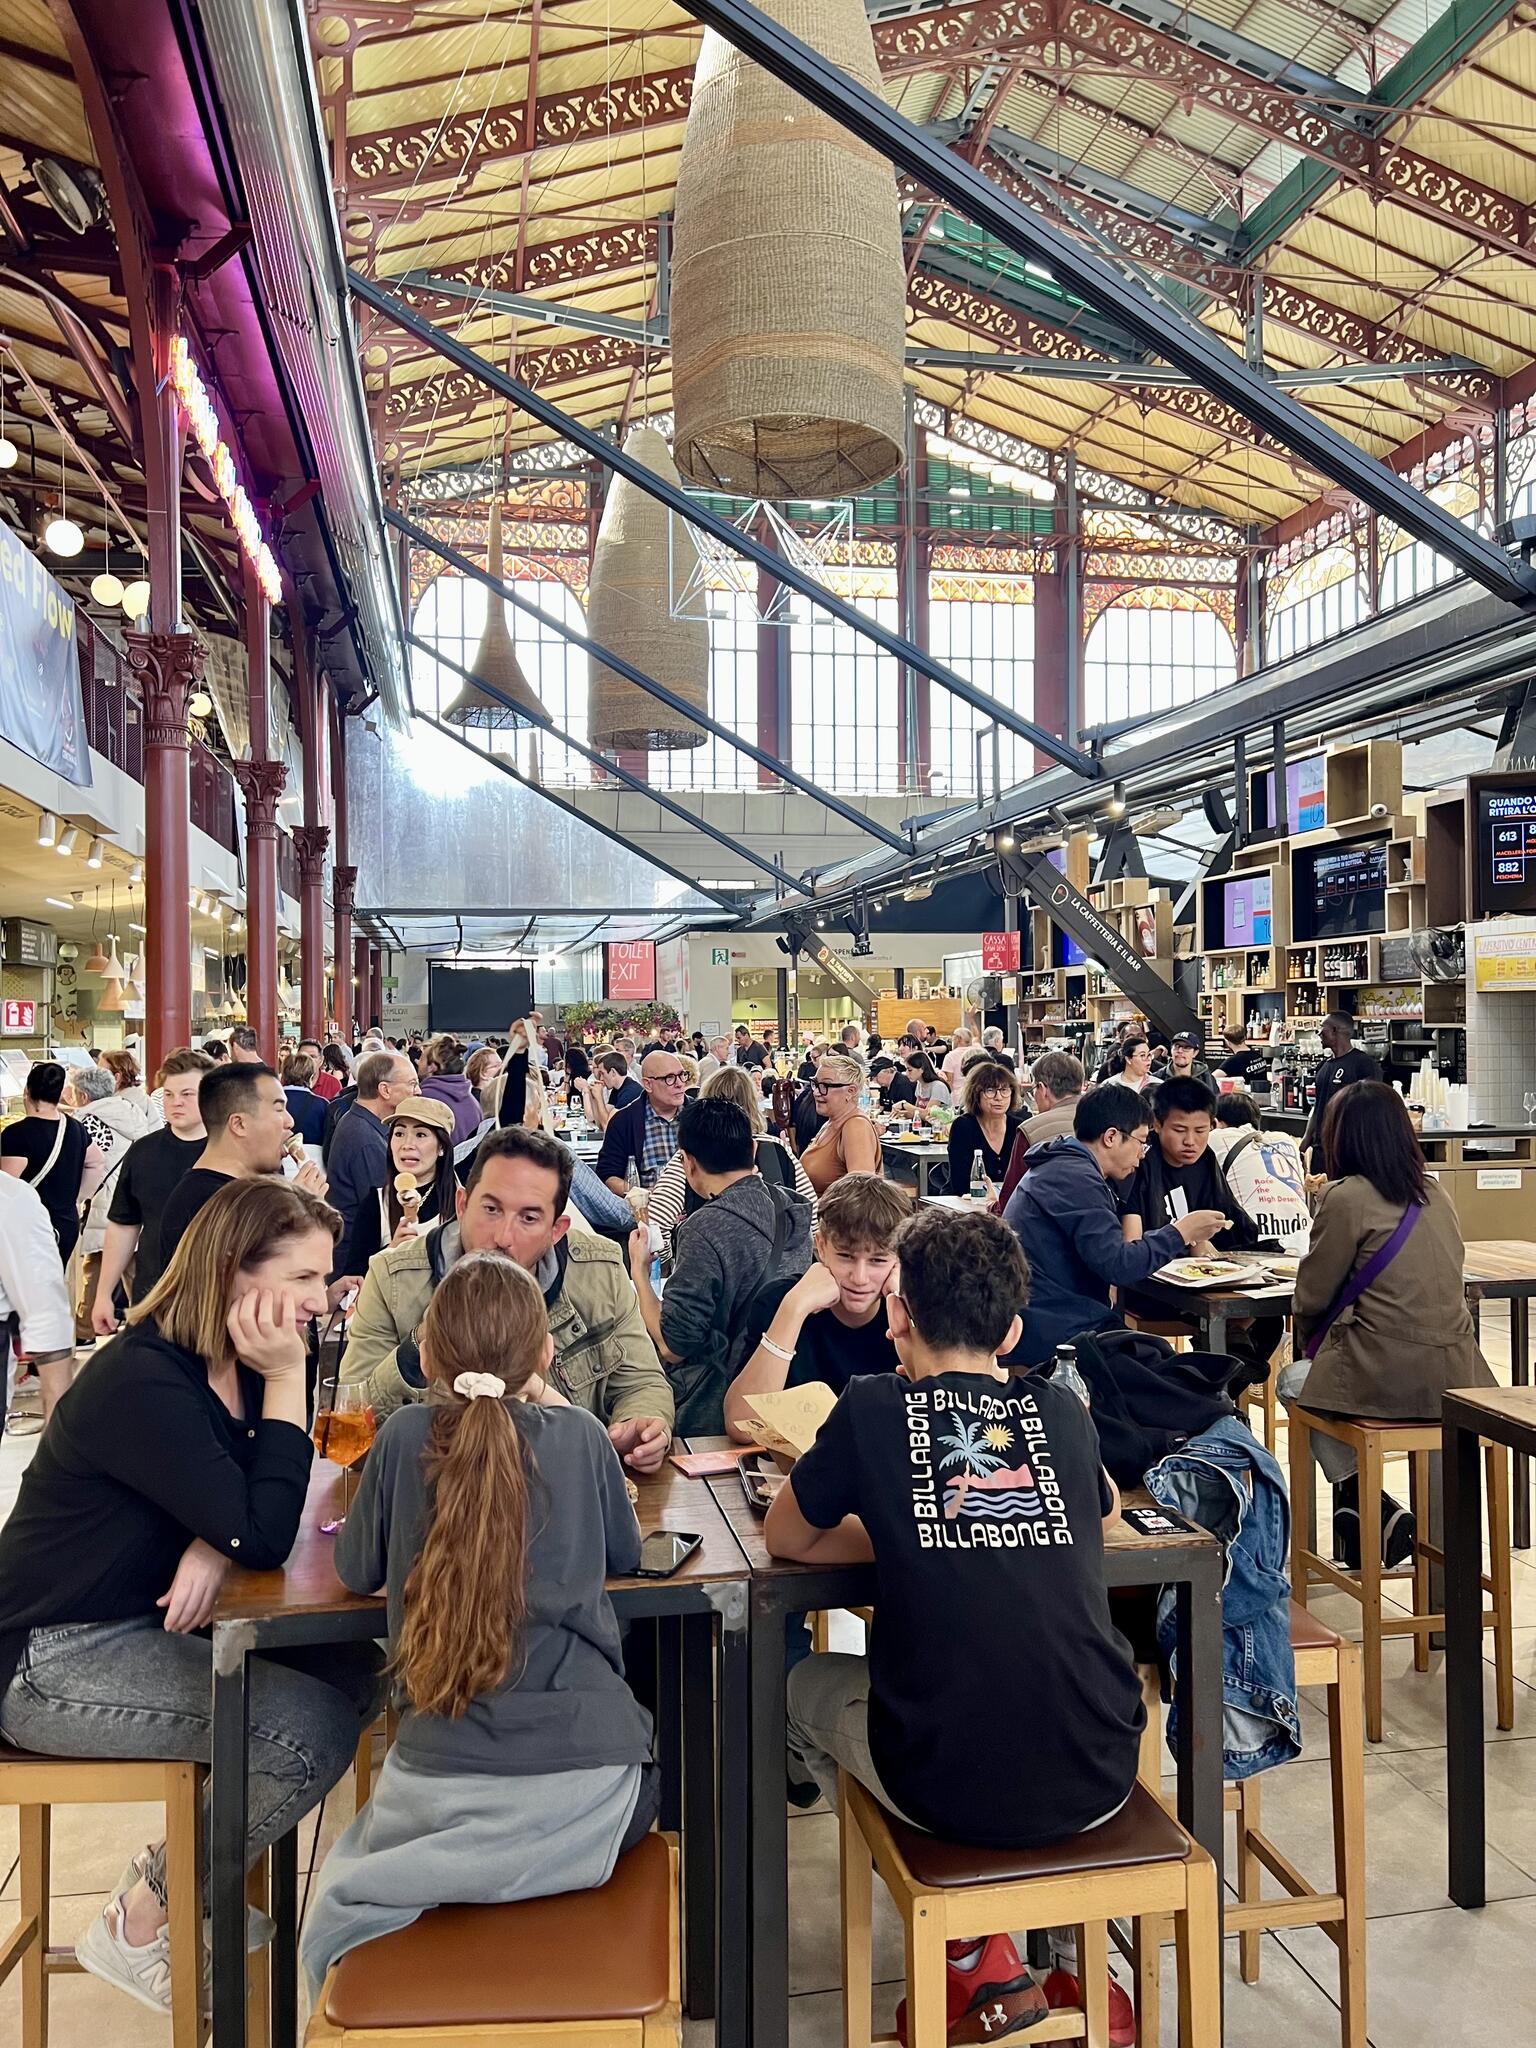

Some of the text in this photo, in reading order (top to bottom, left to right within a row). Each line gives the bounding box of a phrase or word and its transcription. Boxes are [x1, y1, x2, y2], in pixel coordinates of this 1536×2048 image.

[32, 557, 73, 641] Flow
[1488, 796, 1532, 808] QUANDO
[1488, 806, 1522, 817] RITIRA
[1498, 831, 1518, 842] 613
[1498, 861, 1519, 873] 882
[983, 934, 1007, 945] CASSA
[1070, 897, 1079, 910] LA
[1079, 906, 1118, 948] CAFFETTERIA
[1115, 944, 1124, 953] E
[1120, 949, 1128, 960] IL
[1126, 955, 1142, 972] BAR
[611, 942, 650, 960] TOILET
[610, 963, 641, 981] EXIT
[1256, 1186, 1270, 1194] the
[1258, 1195, 1276, 1204] High
[1255, 1212, 1308, 1236] Rhude
[905, 1391, 938, 1519] BILLABONG
[1019, 1417, 1074, 1546] BILLABONG
[1131, 1509, 1158, 1517] 10
[917, 1520, 1051, 1549] BILLABONG
